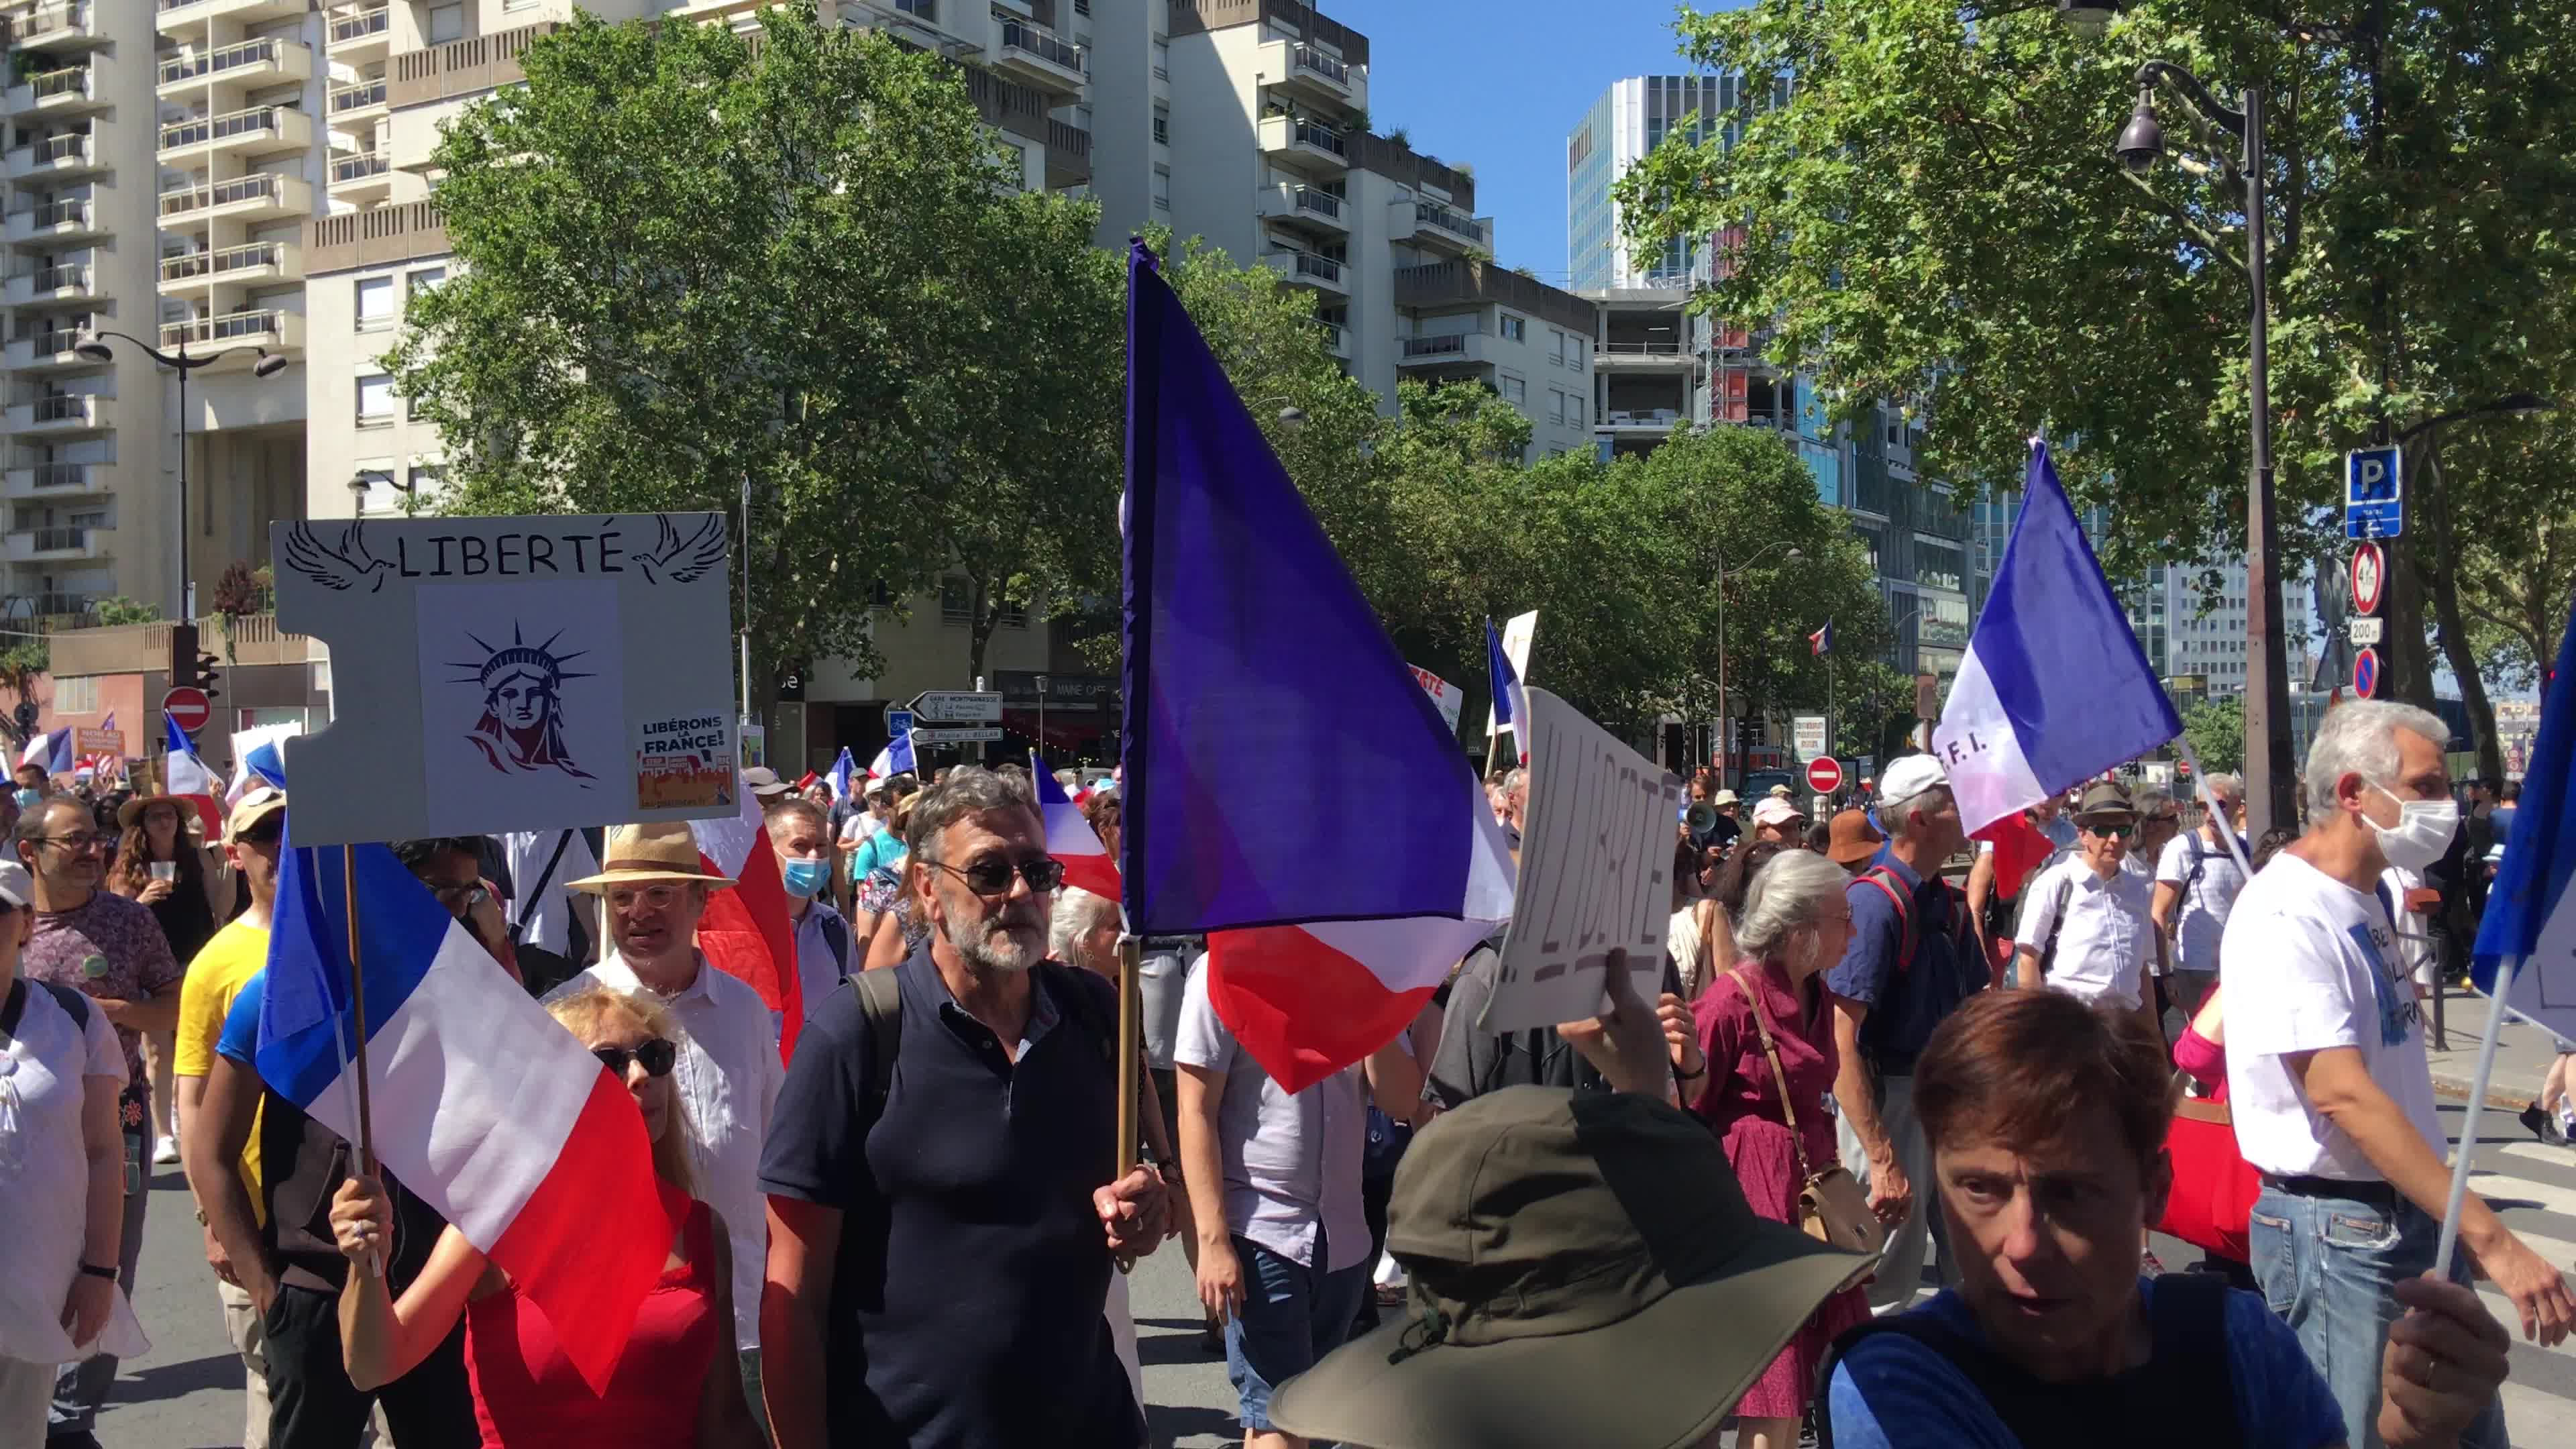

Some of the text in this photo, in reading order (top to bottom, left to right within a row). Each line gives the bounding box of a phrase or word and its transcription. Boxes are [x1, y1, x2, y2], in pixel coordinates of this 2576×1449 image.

[2362, 459, 2384, 494] P
[398, 517, 624, 577] LIBERTÉ
[2353, 623, 2370, 639] 200
[643, 716, 722, 735] LIBÉRONS
[645, 729, 725, 754] FRANCE!
